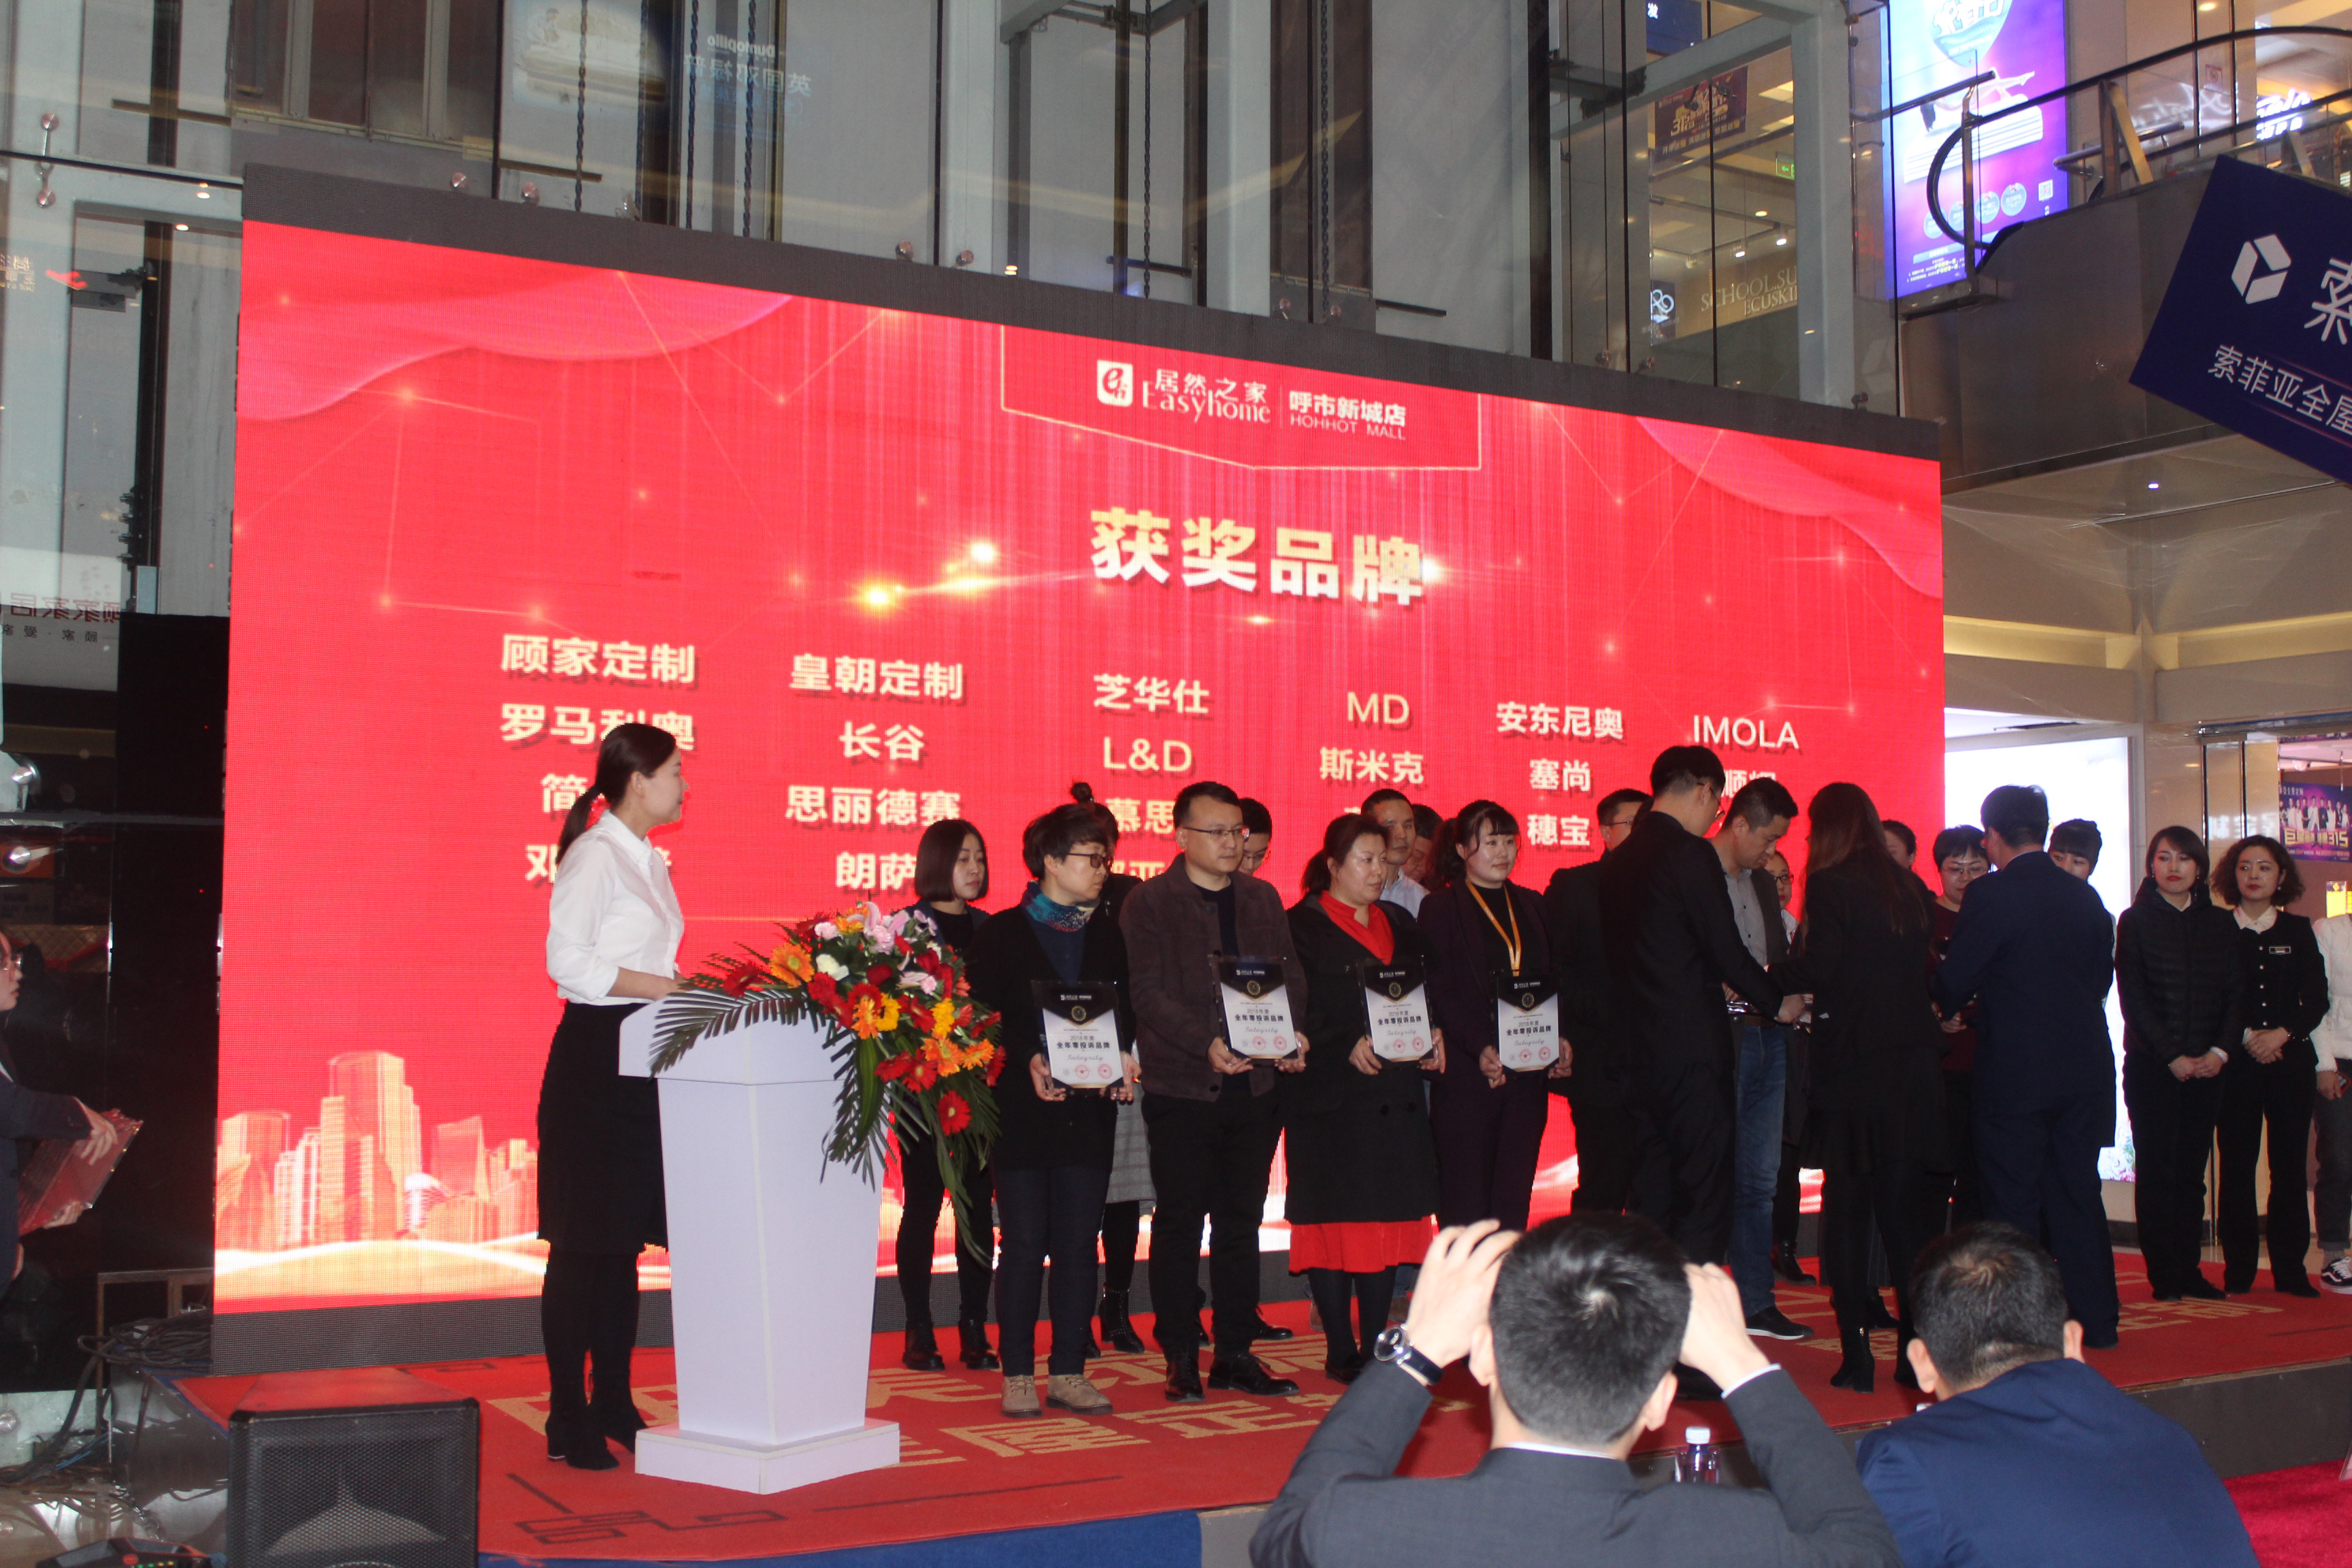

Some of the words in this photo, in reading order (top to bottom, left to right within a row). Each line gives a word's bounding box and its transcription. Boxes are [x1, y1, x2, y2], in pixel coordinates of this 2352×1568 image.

[1143, 380, 1271, 423] Easyhome
[1155, 368, 1267, 404] 居然之家
[1289, 390, 1407, 427] 呼市新城店
[1290, 414, 1358, 434] HOHHOT
[1367, 424, 1407, 440] MALL
[1090, 506, 1423, 606] 获奖品牌
[500, 633, 695, 684] 顾家定制
[789, 652, 964, 700] 皇朝定制
[1093, 672, 1210, 714] 芝华仕
[1347, 691, 1409, 724] MD
[1496, 701, 1624, 740] 安东尼奥
[1693, 715, 1799, 749] IMOLA
[838, 721, 926, 761] 长谷
[1103, 736, 1192, 772] L&D
[1319, 747, 1424, 784] 斯米克
[1529, 758, 1591, 791] 塞尚
[785, 785, 961, 827] 思丽德赛
[1526, 813, 1590, 847] 穗宝
[835, 851, 916, 892] 朗萨
[1235, 1014, 1284, 1022] 全年零投诉品牌
[1378, 1016, 1422, 1026] 全年零投诉品牌
[1507, 1025, 1552, 1036] 全年零投诉品牌
